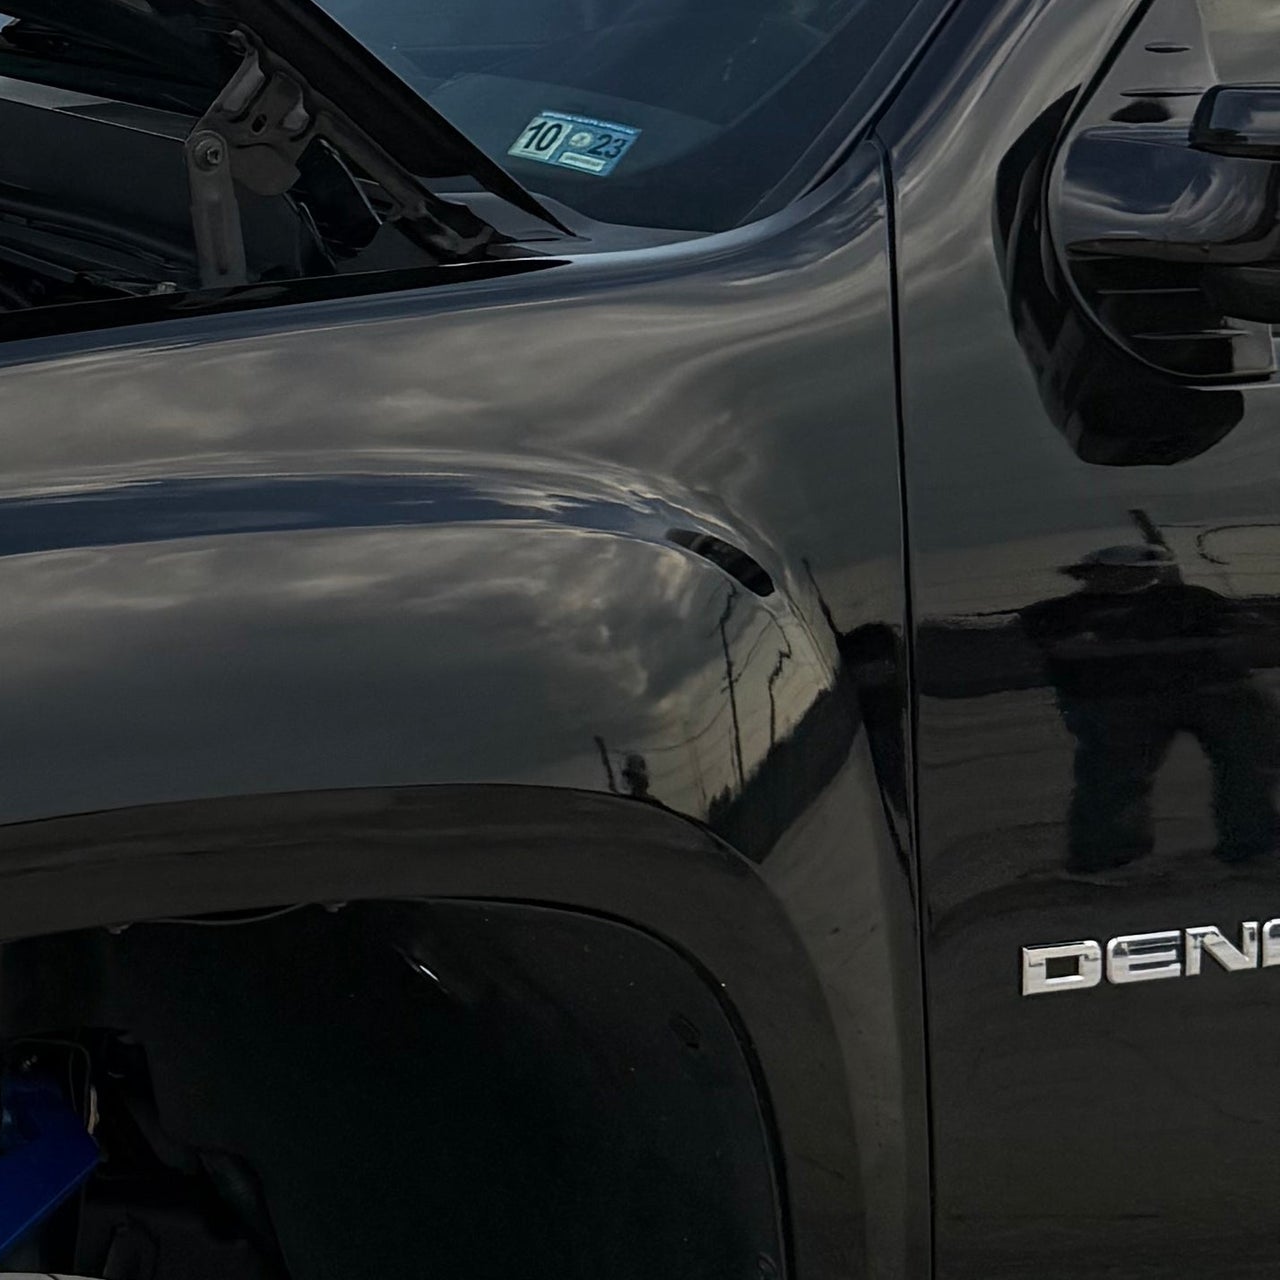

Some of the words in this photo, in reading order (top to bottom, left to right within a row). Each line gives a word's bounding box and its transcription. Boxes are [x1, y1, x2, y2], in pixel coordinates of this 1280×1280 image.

[523, 120, 563, 152] 10
[587, 133, 628, 159] 23
[1022, 918, 1280, 997] DEN
